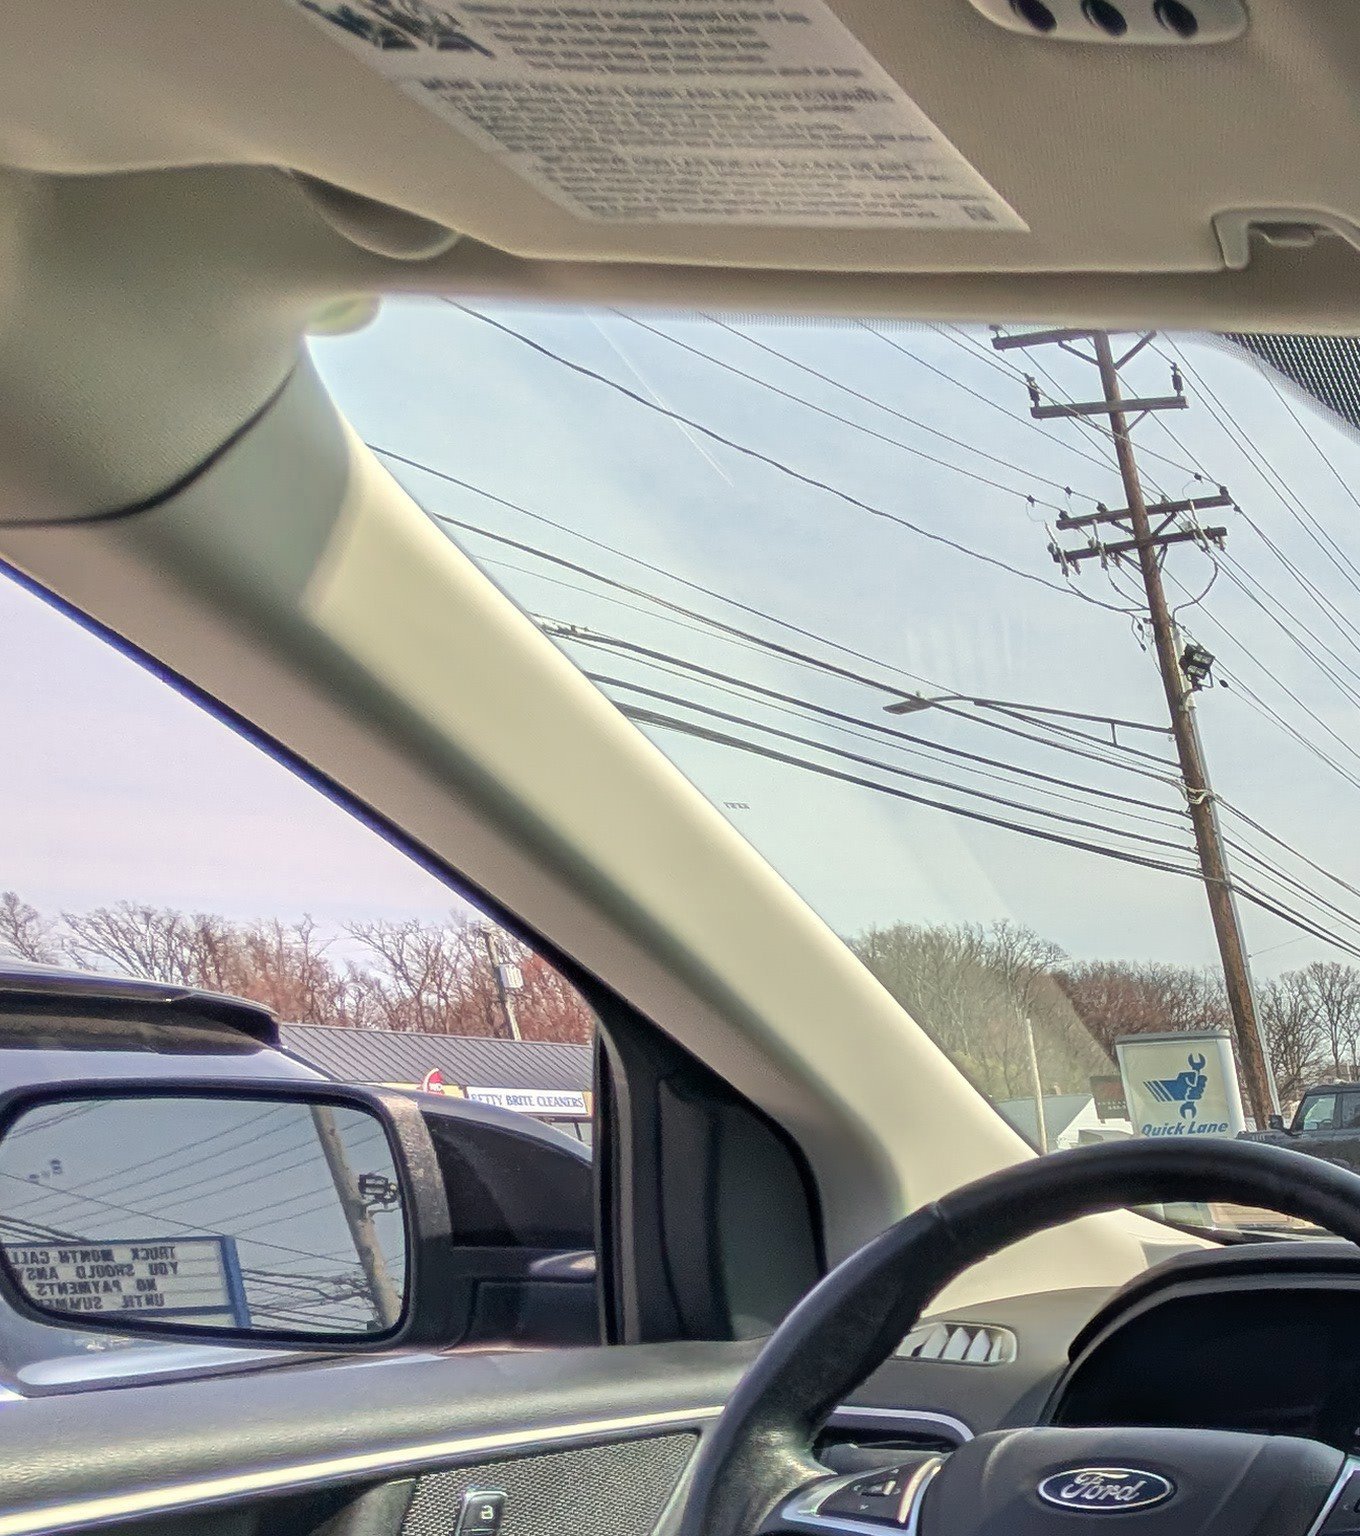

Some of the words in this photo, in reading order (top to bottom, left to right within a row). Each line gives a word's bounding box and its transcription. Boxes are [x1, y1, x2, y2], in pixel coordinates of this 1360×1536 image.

[505, 1095, 535, 1107] BRITE
[537, 1096, 584, 1108] CLEANERS
[1141, 1122, 1185, 1137] Quick
[1187, 1121, 1229, 1134] Lane
[1060, 1471, 1147, 1501] Ford
